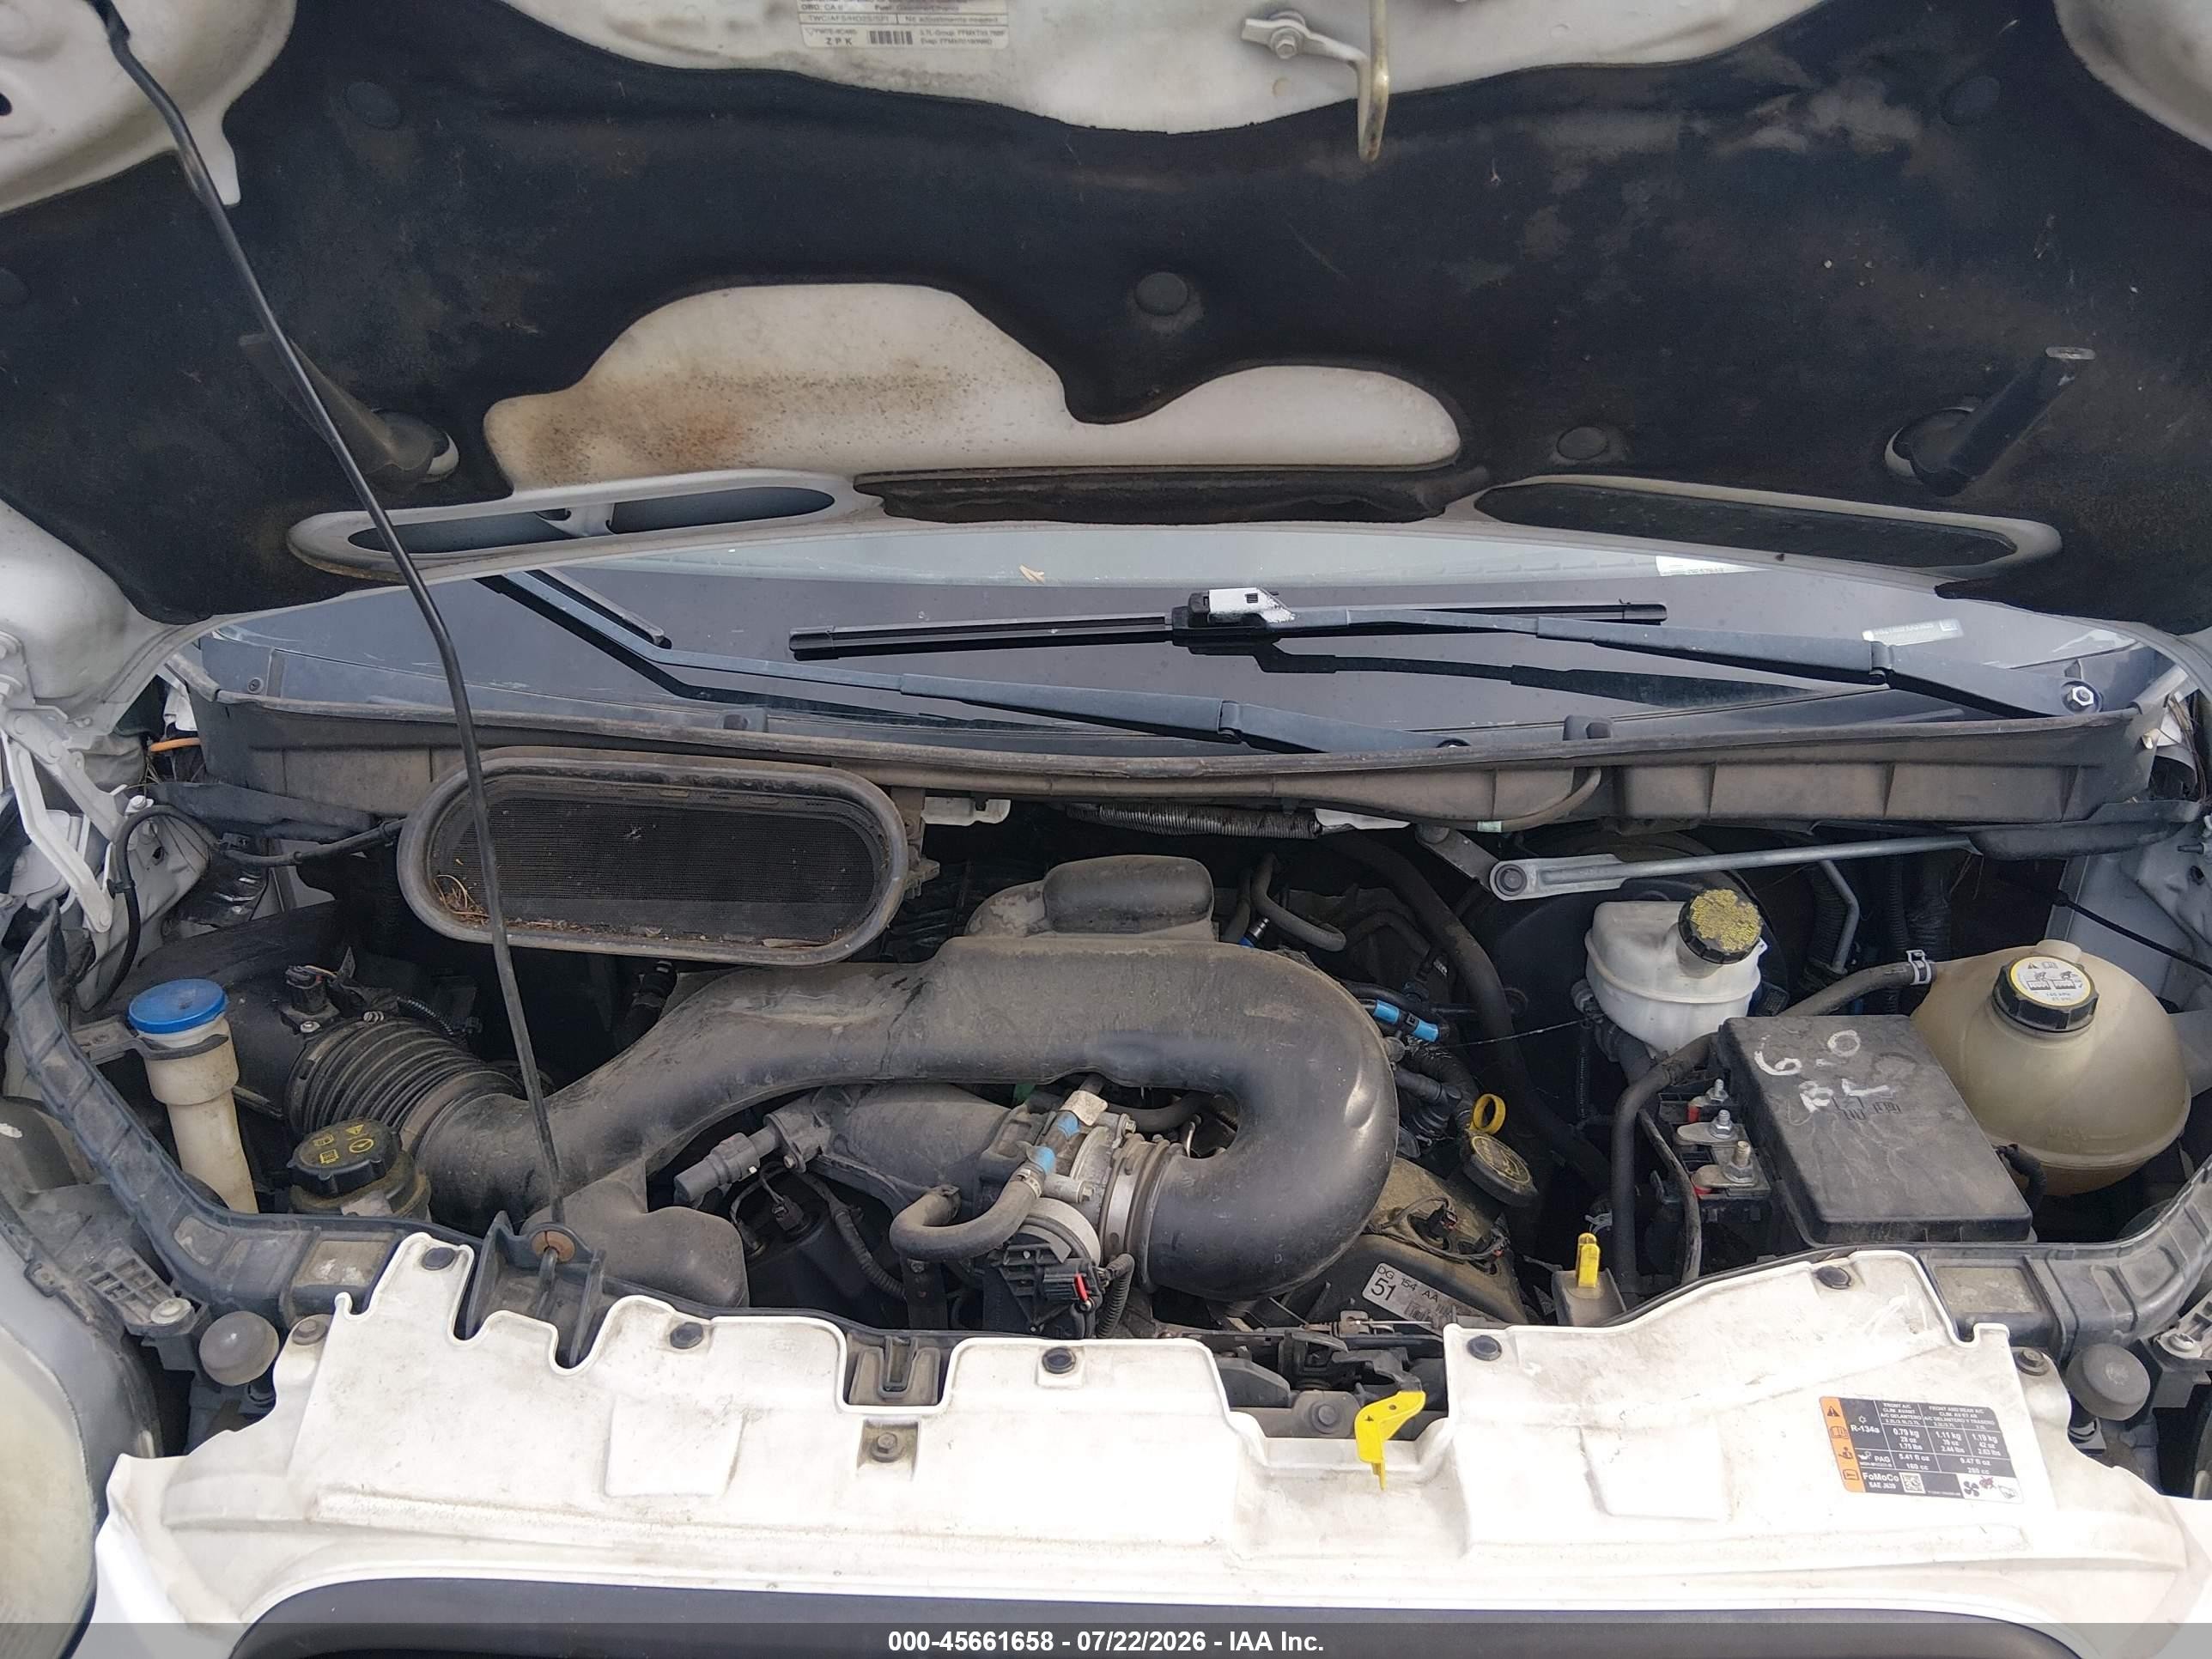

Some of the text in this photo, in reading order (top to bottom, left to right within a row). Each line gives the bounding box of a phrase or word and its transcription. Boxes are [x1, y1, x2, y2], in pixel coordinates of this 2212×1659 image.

[1370, 1277, 1396, 1301] 51
[1376, 1266, 1438, 1303] DG 154 AA
[1850, 1425, 1880, 1434] R-134a
[1893, 1427, 1920, 1438] 0.79 kg
[1936, 1431, 1962, 1441] 1.11 kg
[1987, 1435, 1998, 1444] kg
[1863, 1472, 1899, 1481] FoMoCo
